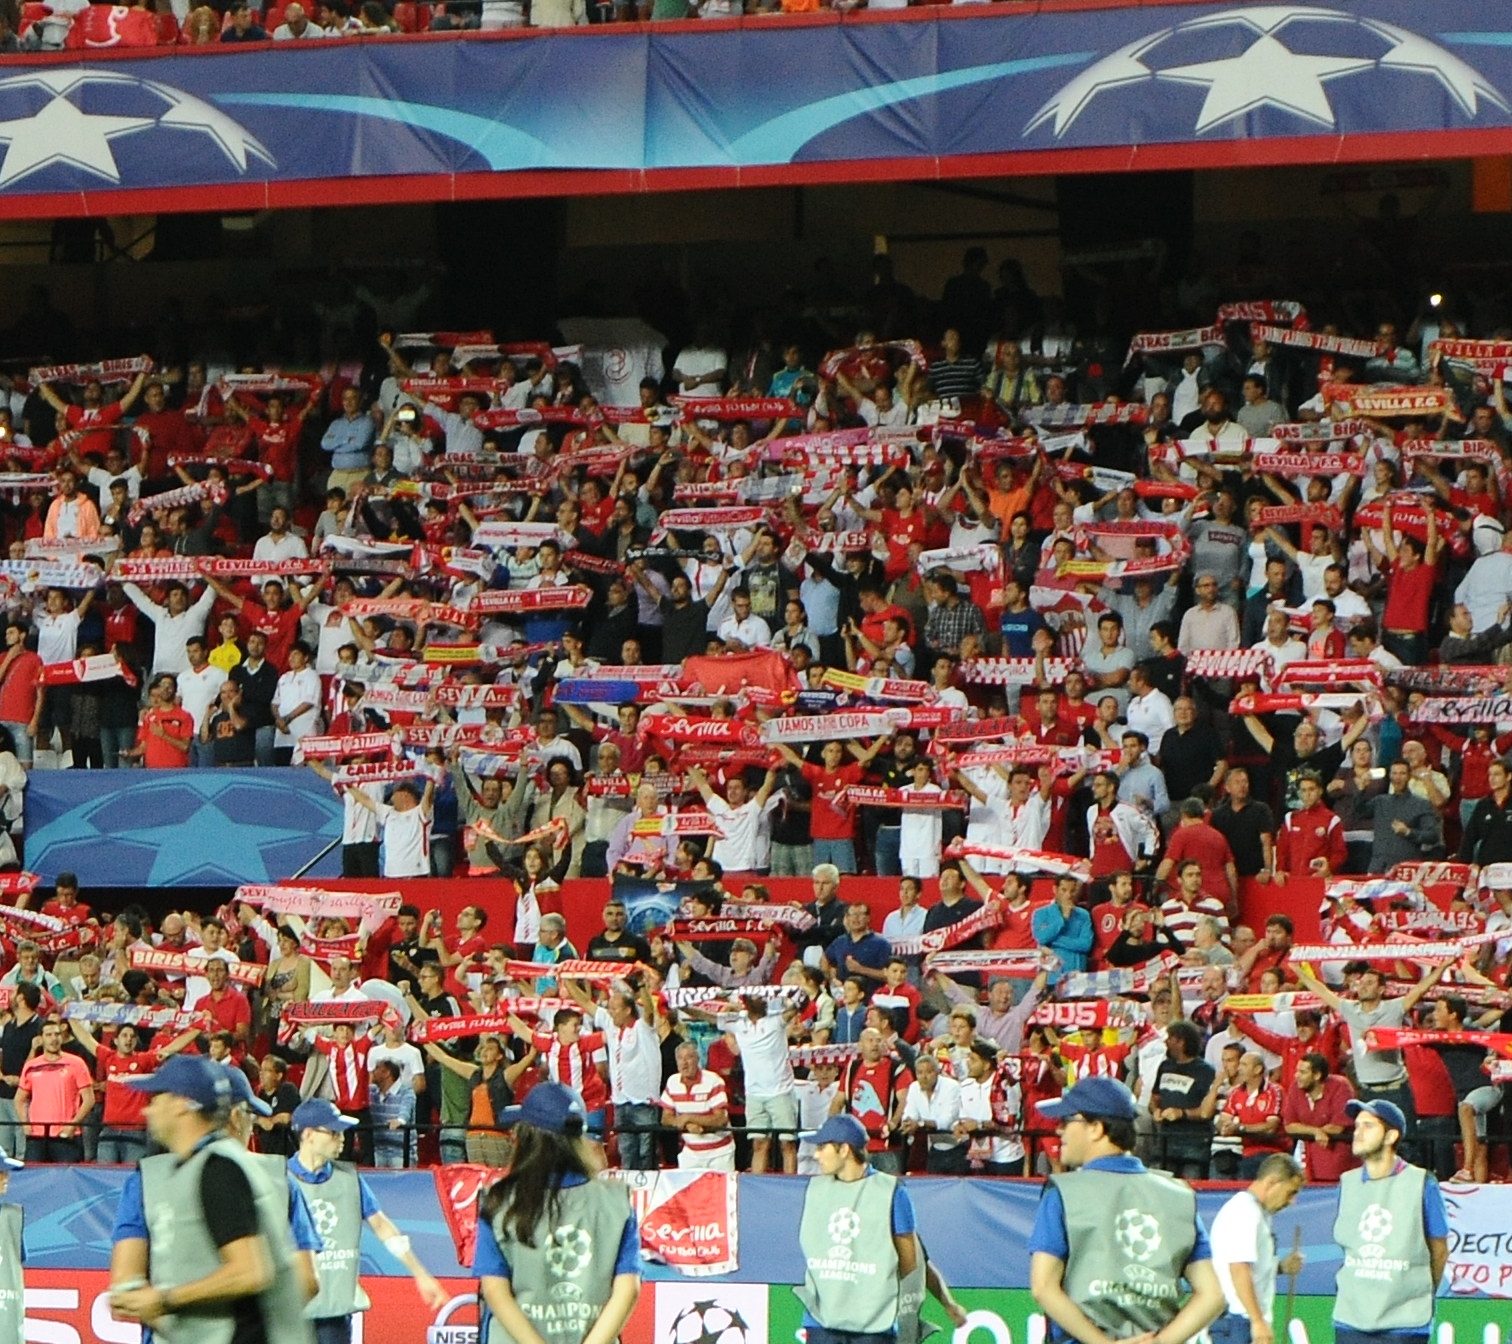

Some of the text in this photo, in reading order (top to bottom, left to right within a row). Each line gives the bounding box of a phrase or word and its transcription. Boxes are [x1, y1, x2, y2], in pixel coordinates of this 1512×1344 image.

[101, 359, 136, 373] BIRIS
[1356, 398, 1407, 409] SEVILLA
[1261, 456, 1309, 467] SEVILLA
[215, 559, 267, 570] SEVILLA
[480, 597, 509, 606] SEVILLA
[660, 716, 731, 736] Sevilla
[775, 715, 870, 734] VAMOS COPA
[591, 777, 627, 785] SEVILLA
[745, 906, 776, 919] Sevilla
[688, 918, 736, 933] Sevilla
[133, 951, 181, 969] BIRIS
[828, 1246, 852, 1260] UEFA
[1357, 1244, 1386, 1257] UEFA
[1122, 1263, 1156, 1282] UEFA
[436, 1331, 478, 1344] NISS
